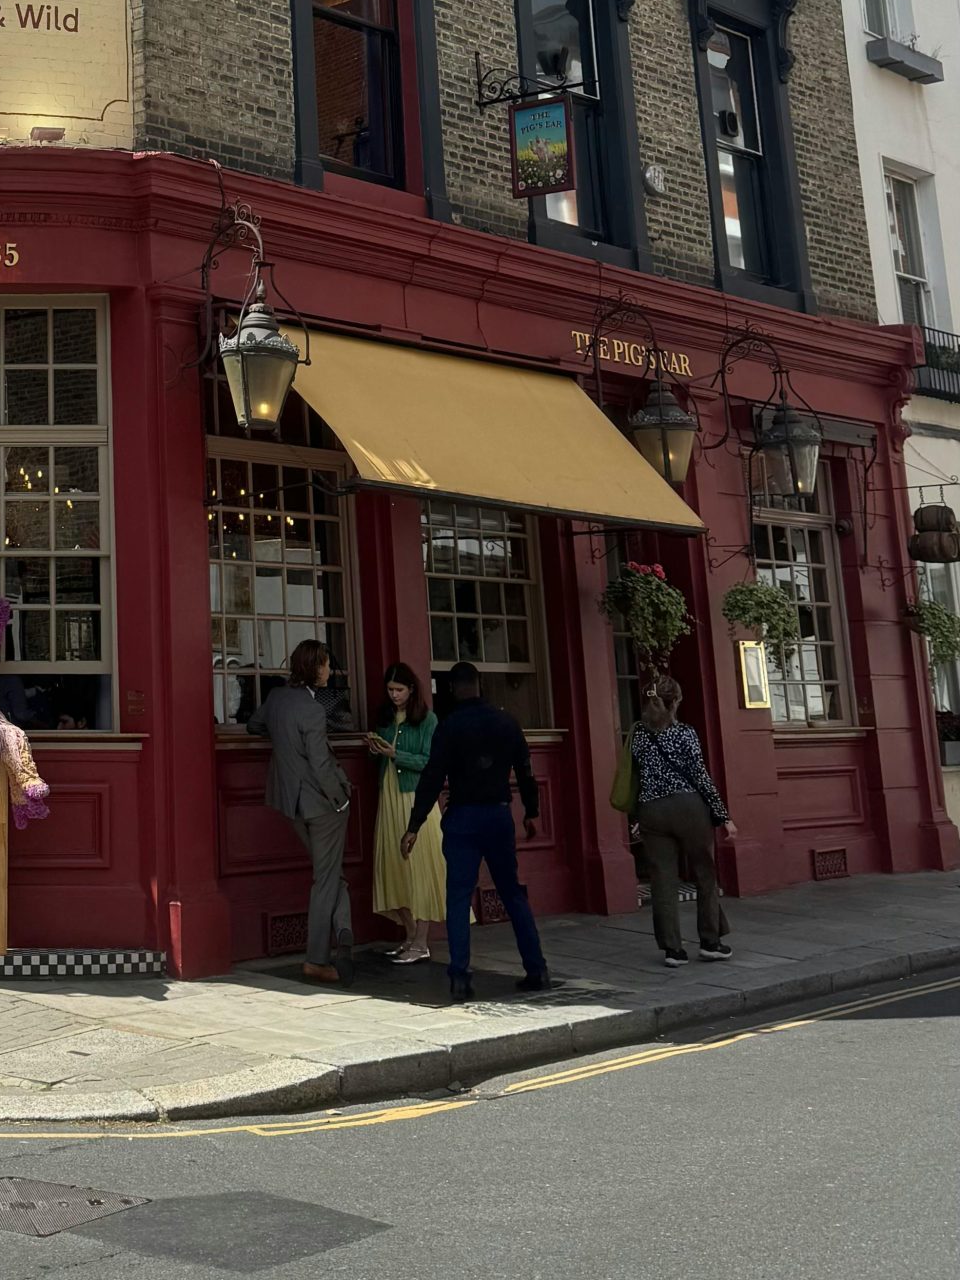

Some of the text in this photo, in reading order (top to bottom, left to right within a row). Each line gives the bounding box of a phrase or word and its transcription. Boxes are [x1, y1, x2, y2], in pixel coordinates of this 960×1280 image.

[15, 3, 80, 33] Wild
[530, 111, 550, 120] THE
[545, 120, 562, 129] EAR
